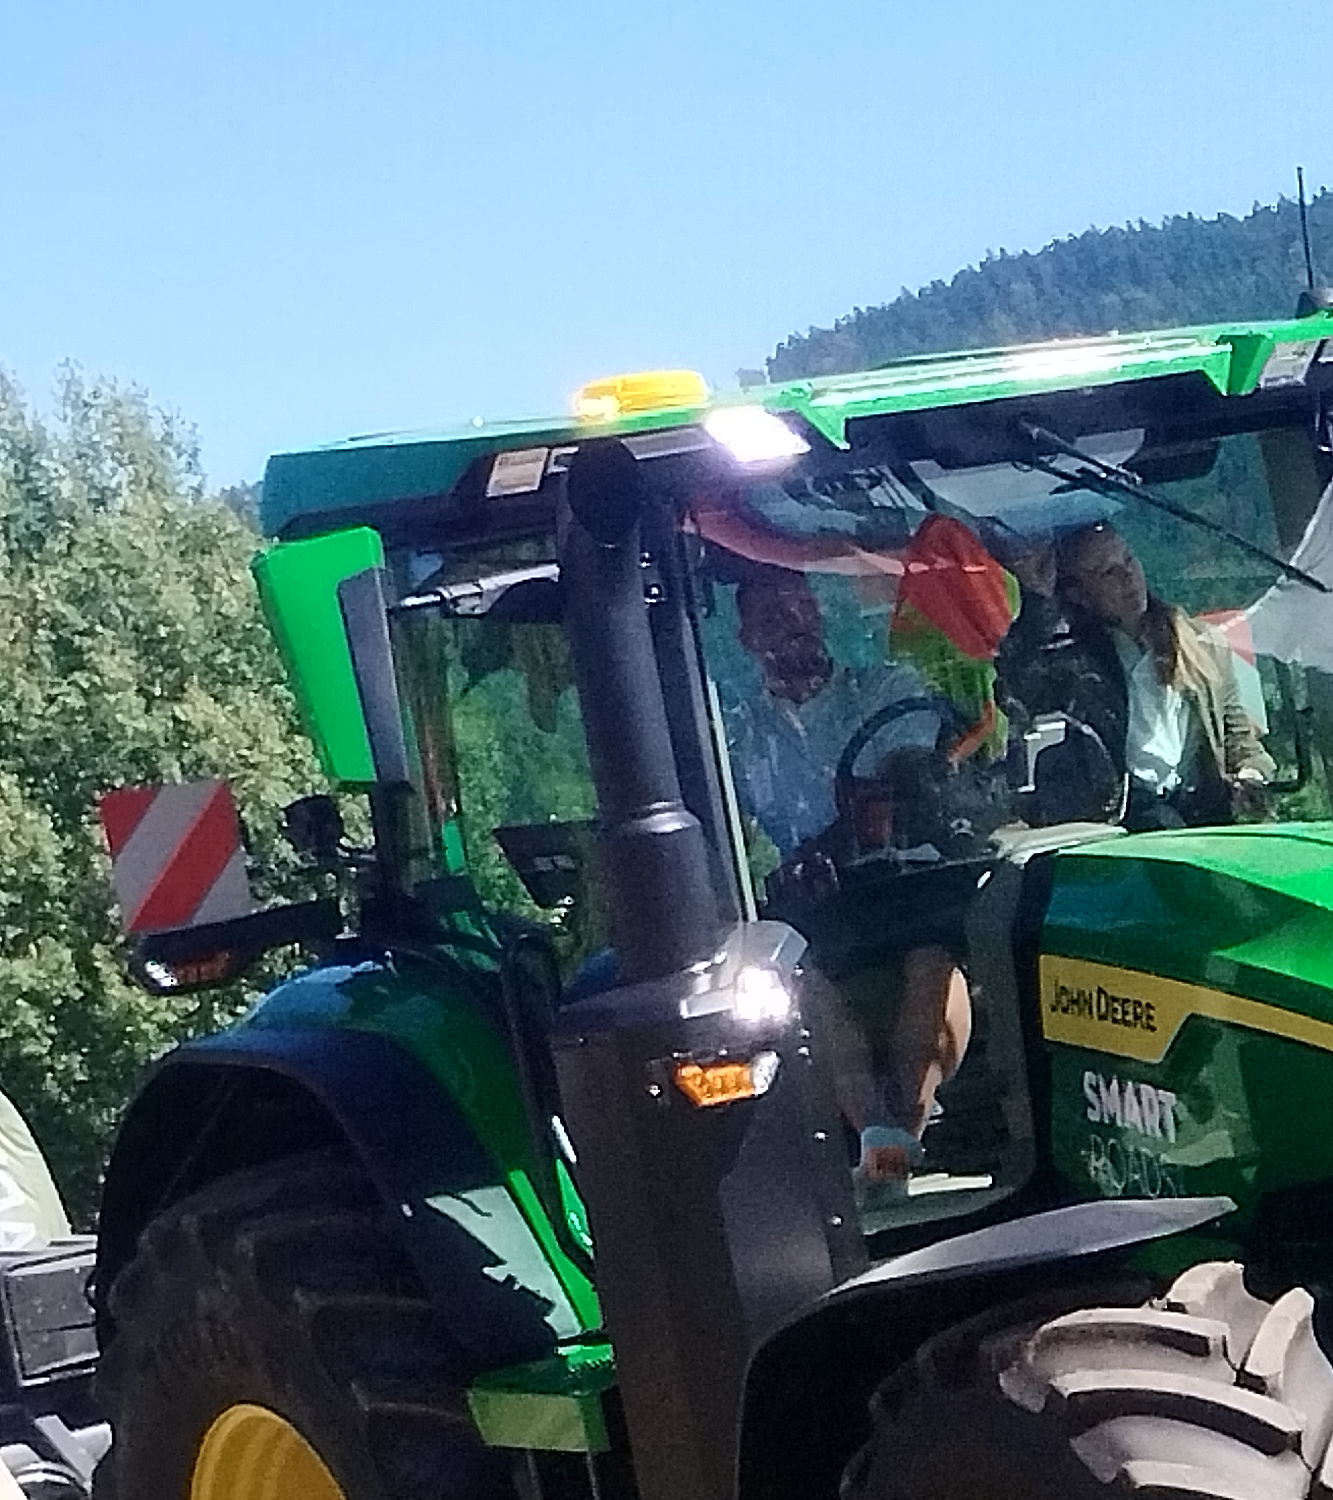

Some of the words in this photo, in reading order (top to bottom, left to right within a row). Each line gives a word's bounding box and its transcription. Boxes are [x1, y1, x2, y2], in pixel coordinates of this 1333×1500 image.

[1048, 979, 1095, 1021] JOHN
[1096, 985, 1158, 1032] DEERE
[1083, 1070, 1176, 1144] SMART
